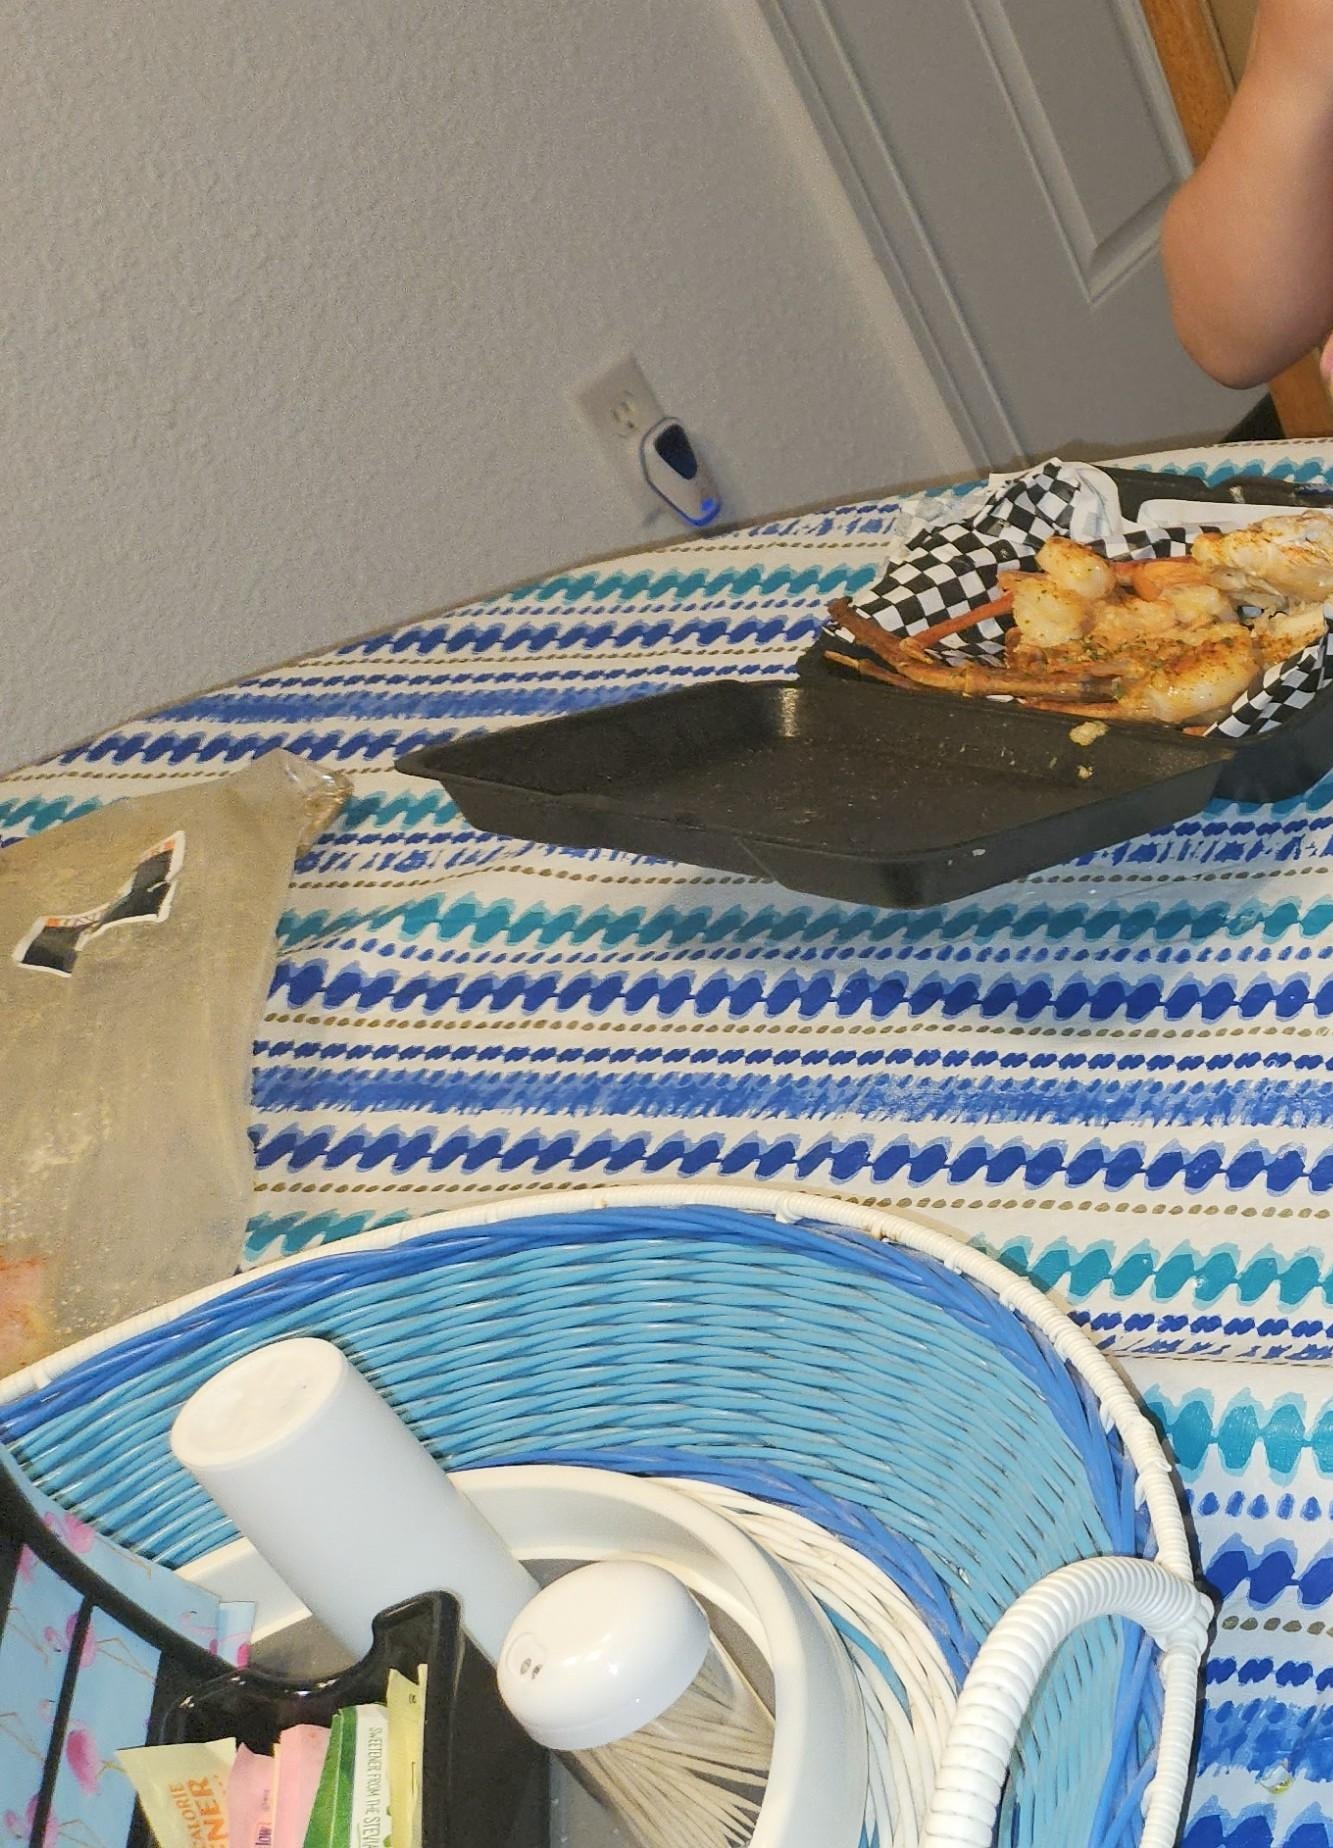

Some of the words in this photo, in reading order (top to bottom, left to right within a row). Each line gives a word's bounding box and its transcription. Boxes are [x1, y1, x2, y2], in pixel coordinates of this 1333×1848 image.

[367, 1727, 383, 1771] SWEETENER
[367, 1773, 383, 1797] FROM
[187, 1776, 229, 1848] NER
[365, 1798, 381, 1816] THE
